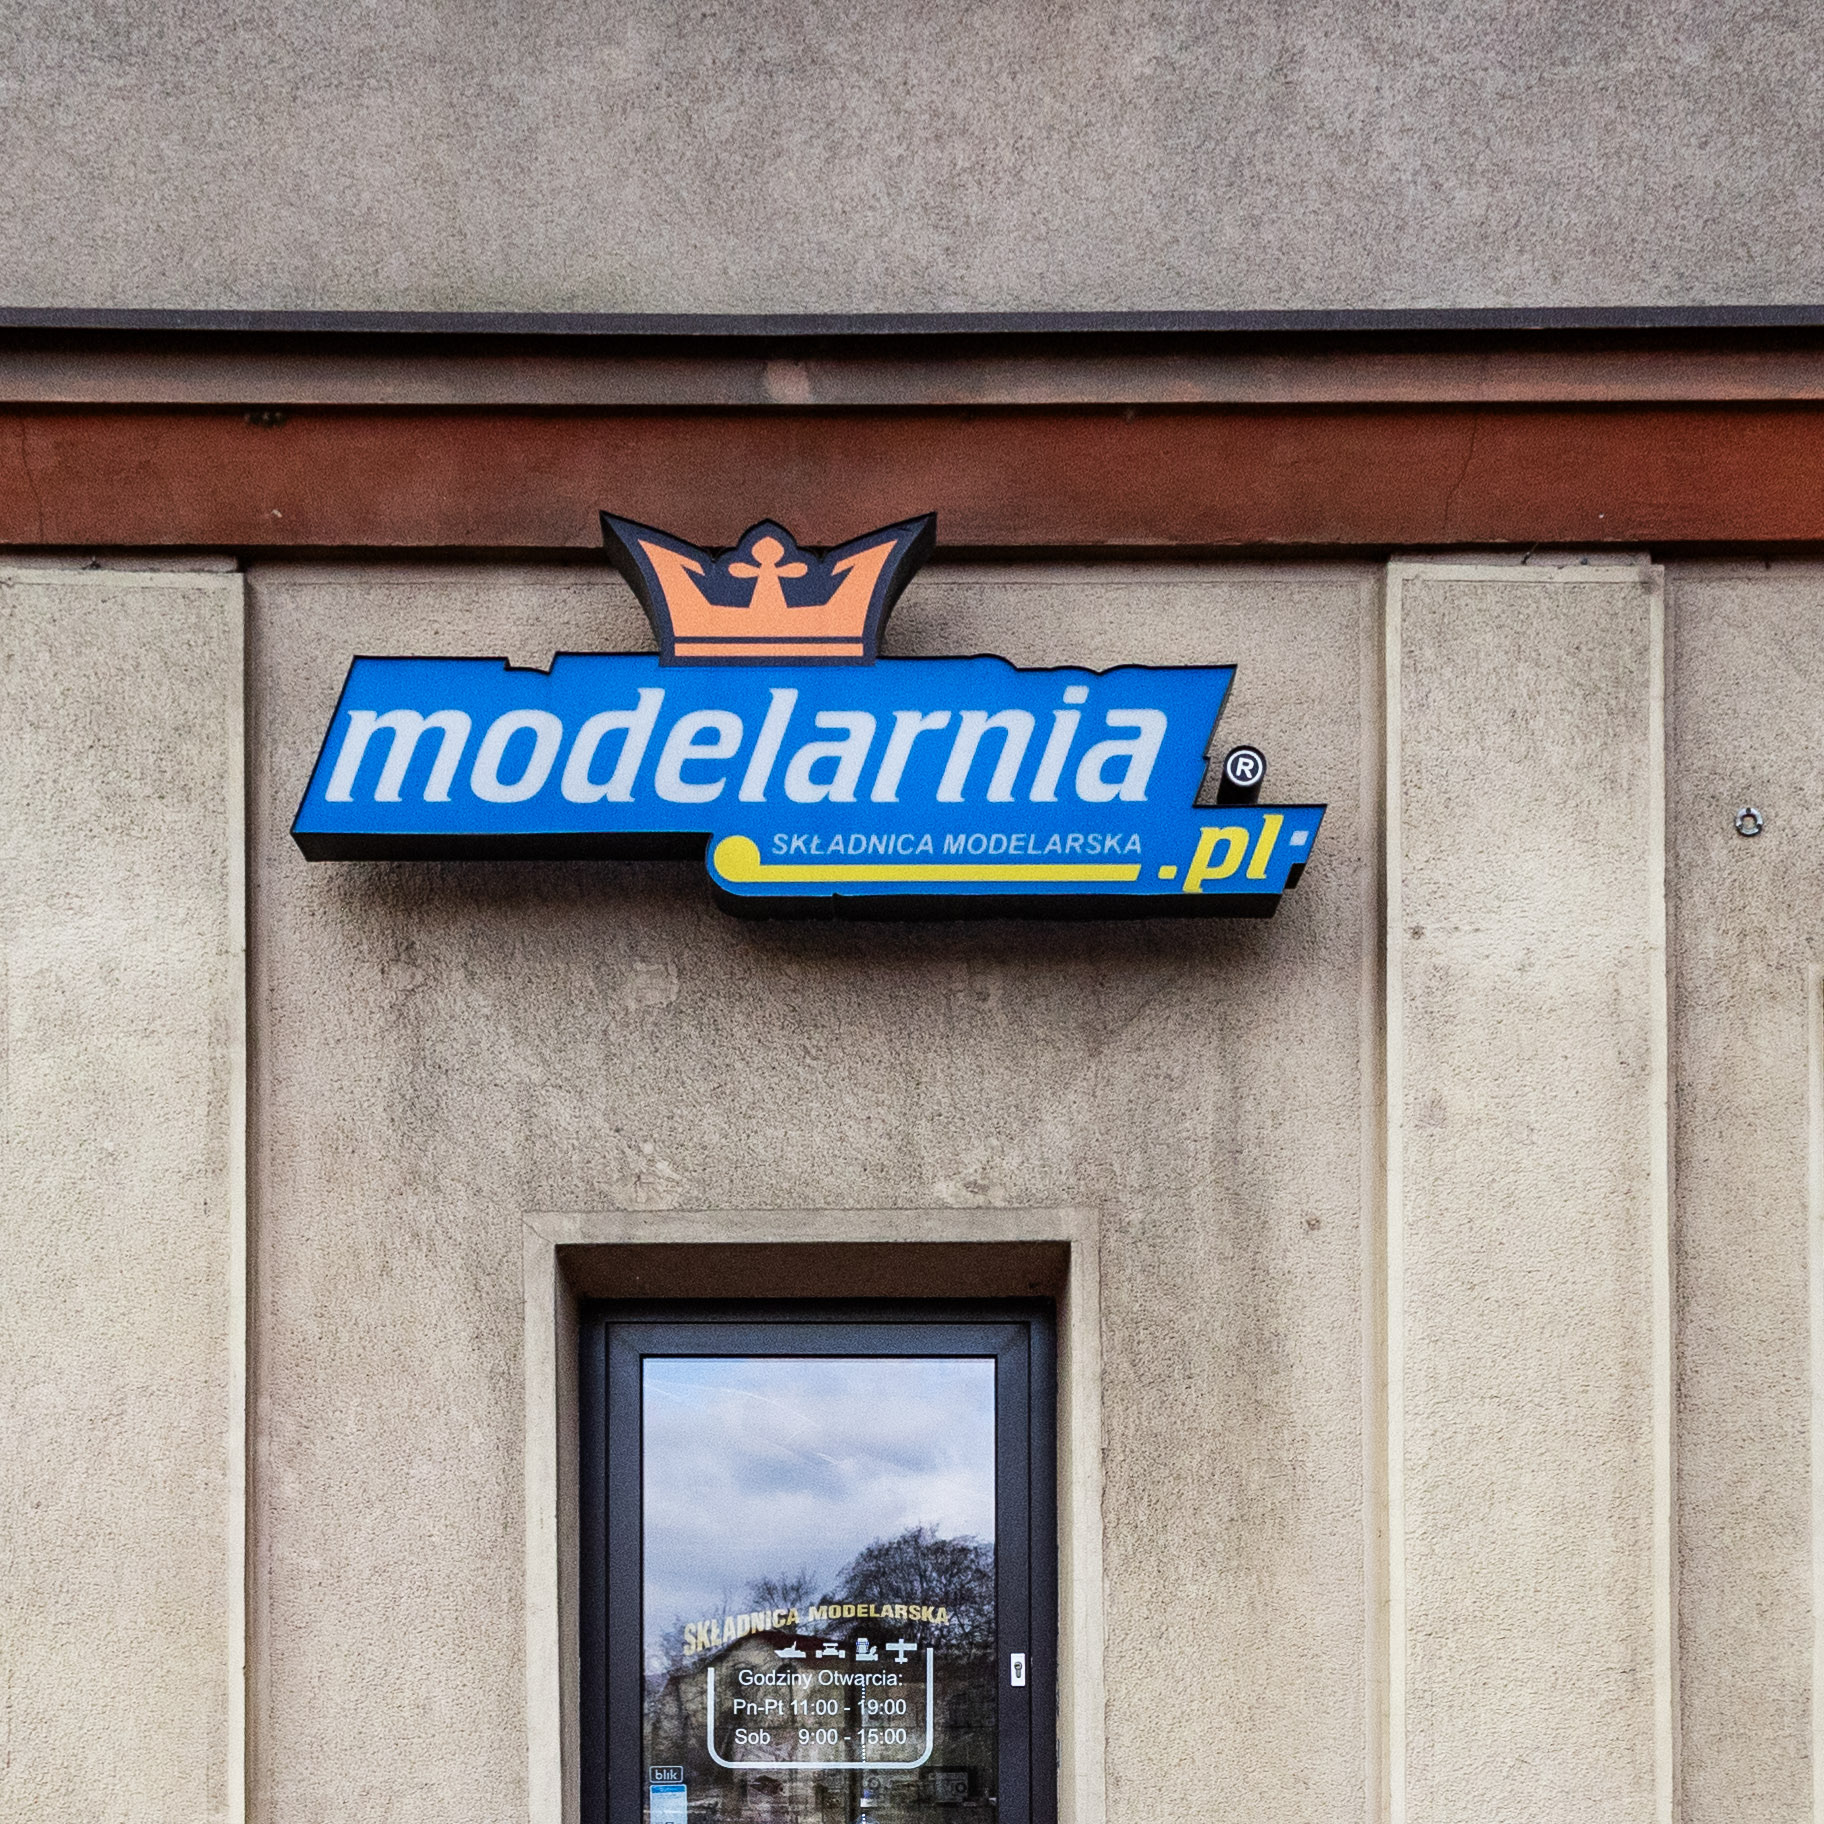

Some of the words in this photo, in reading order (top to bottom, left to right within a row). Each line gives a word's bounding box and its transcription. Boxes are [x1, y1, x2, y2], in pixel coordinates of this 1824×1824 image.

[323, 686, 1170, 805] modelarnia
[772, 832, 934, 856] SKŁADNICA
[942, 832, 1144, 856] MODELARSKA
[1157, 813, 1286, 893] .pl
[683, 1608, 800, 1656] SKŁADNICA
[808, 1603, 950, 1626] MODELARSKA
[738, 1669, 813, 1689] Godziny
[818, 1669, 904, 1687] Otwarcia:
[733, 1698, 785, 1715] Pn-Pt
[790, 1698, 839, 1715] 11:00
[858, 1698, 907, 1715] 19:00
[734, 1728, 771, 1745] Sob
[798, 1728, 839, 1745] 9:00
[858, 1728, 907, 1745] 15:00
[655, 1769, 677, 1780] blik
